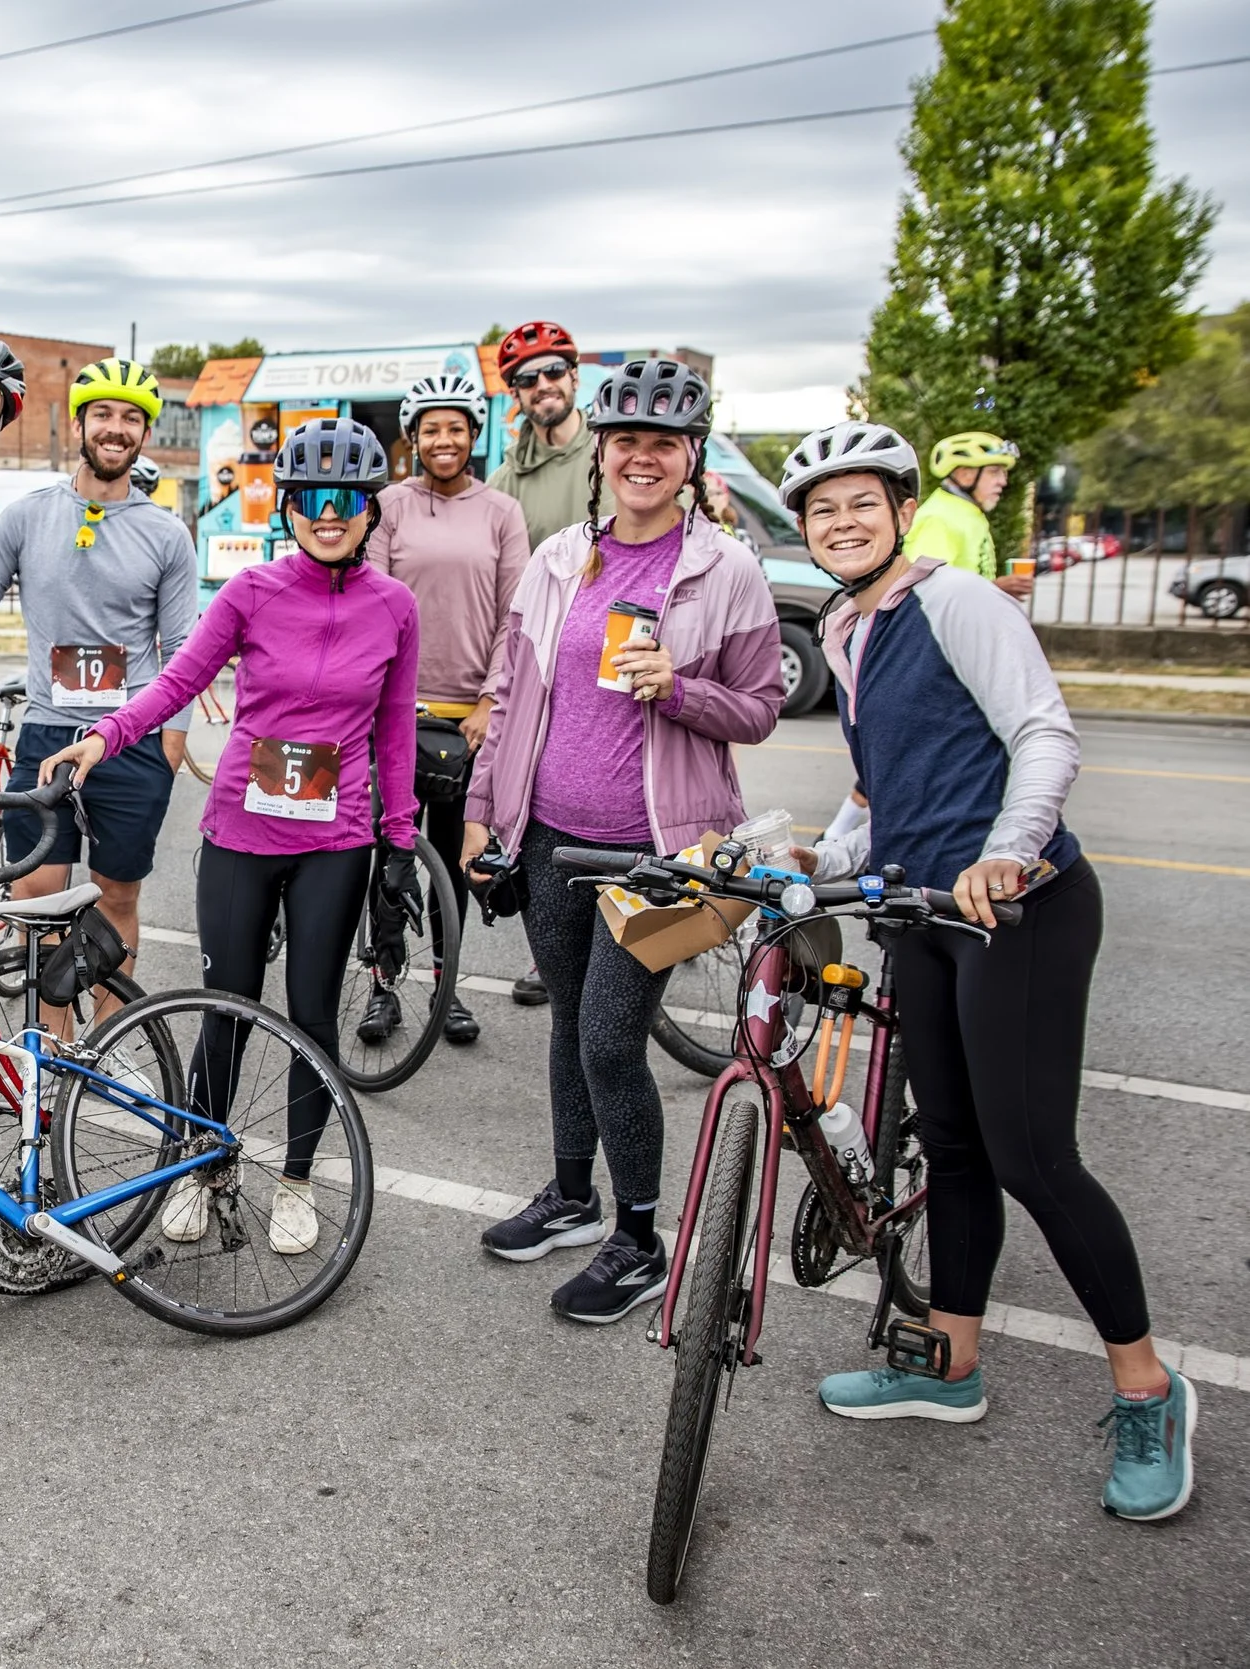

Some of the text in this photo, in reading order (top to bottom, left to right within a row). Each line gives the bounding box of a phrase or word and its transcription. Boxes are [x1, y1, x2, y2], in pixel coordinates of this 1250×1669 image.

[313, 361, 400, 386] TOM'S
[673, 587, 698, 600] NIKE
[76, 659, 104, 688] 19
[284, 759, 303, 795] 5
